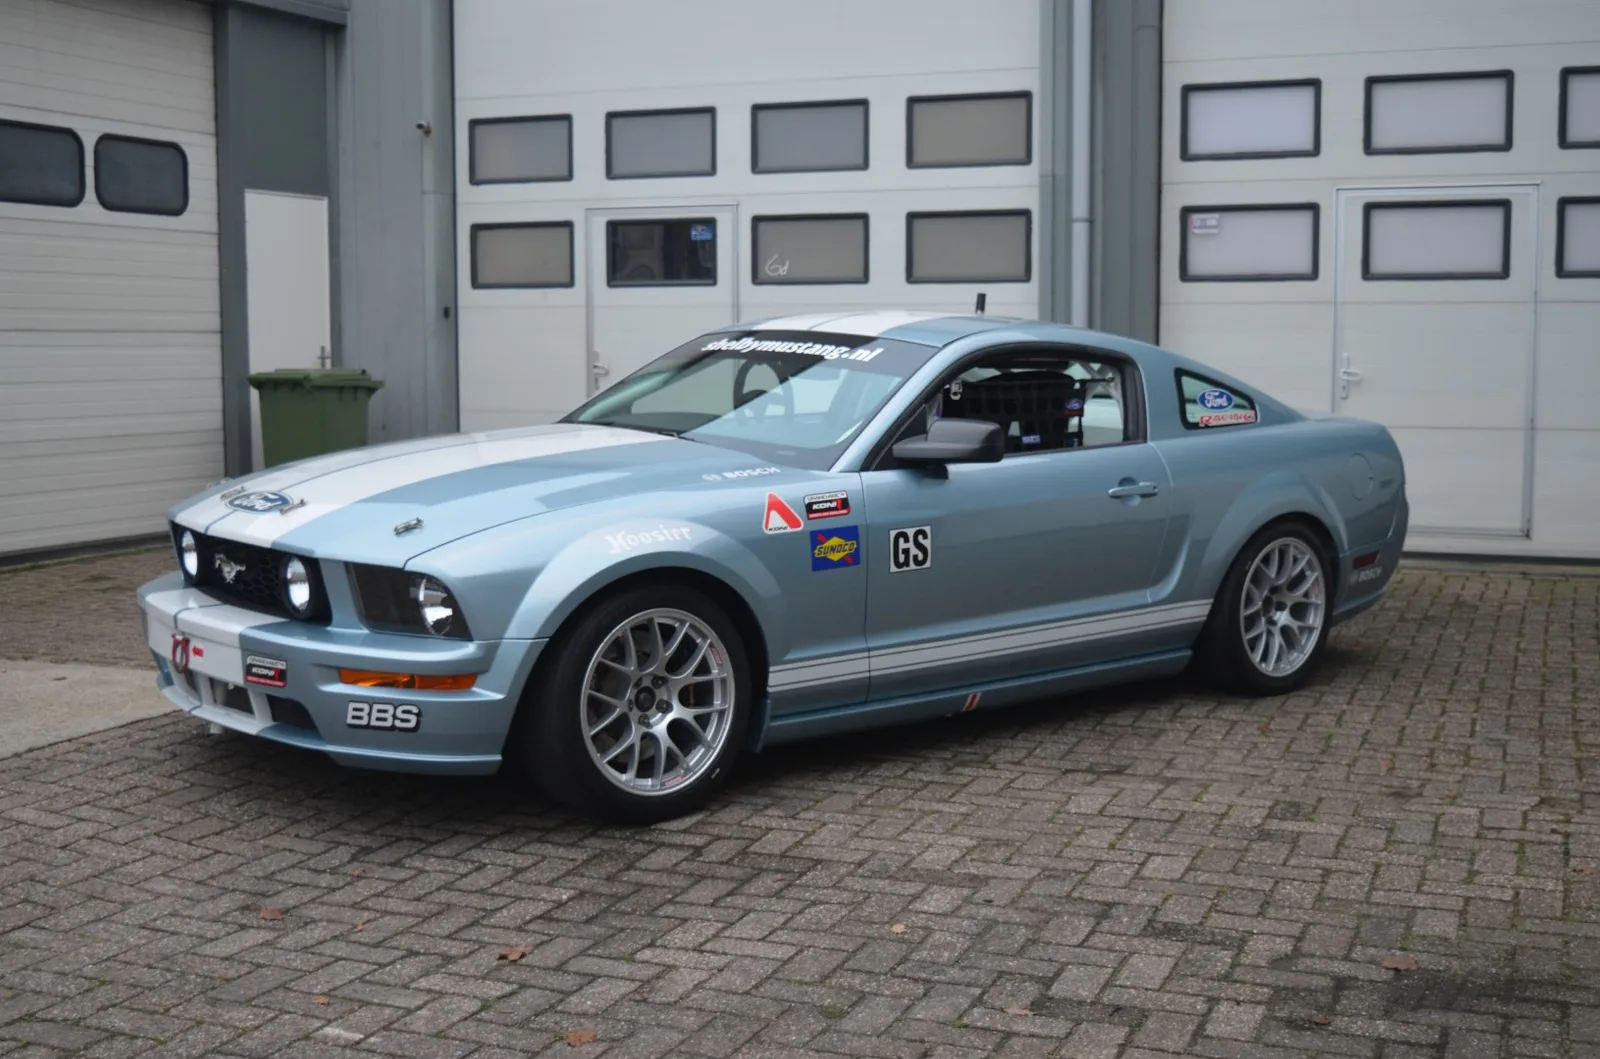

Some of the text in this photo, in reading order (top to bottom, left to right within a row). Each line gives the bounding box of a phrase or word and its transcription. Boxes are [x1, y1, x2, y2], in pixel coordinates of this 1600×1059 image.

[701, 337, 884, 362] shelbymustang.nl
[1204, 391, 1229, 408] Ford
[721, 466, 781, 479] BOSCH
[234, 493, 282, 511] Ford
[604, 524, 691, 554] Hoosier
[816, 542, 855, 556] SUNOCO
[893, 528, 929, 569] GS
[346, 701, 419, 729] BBS
